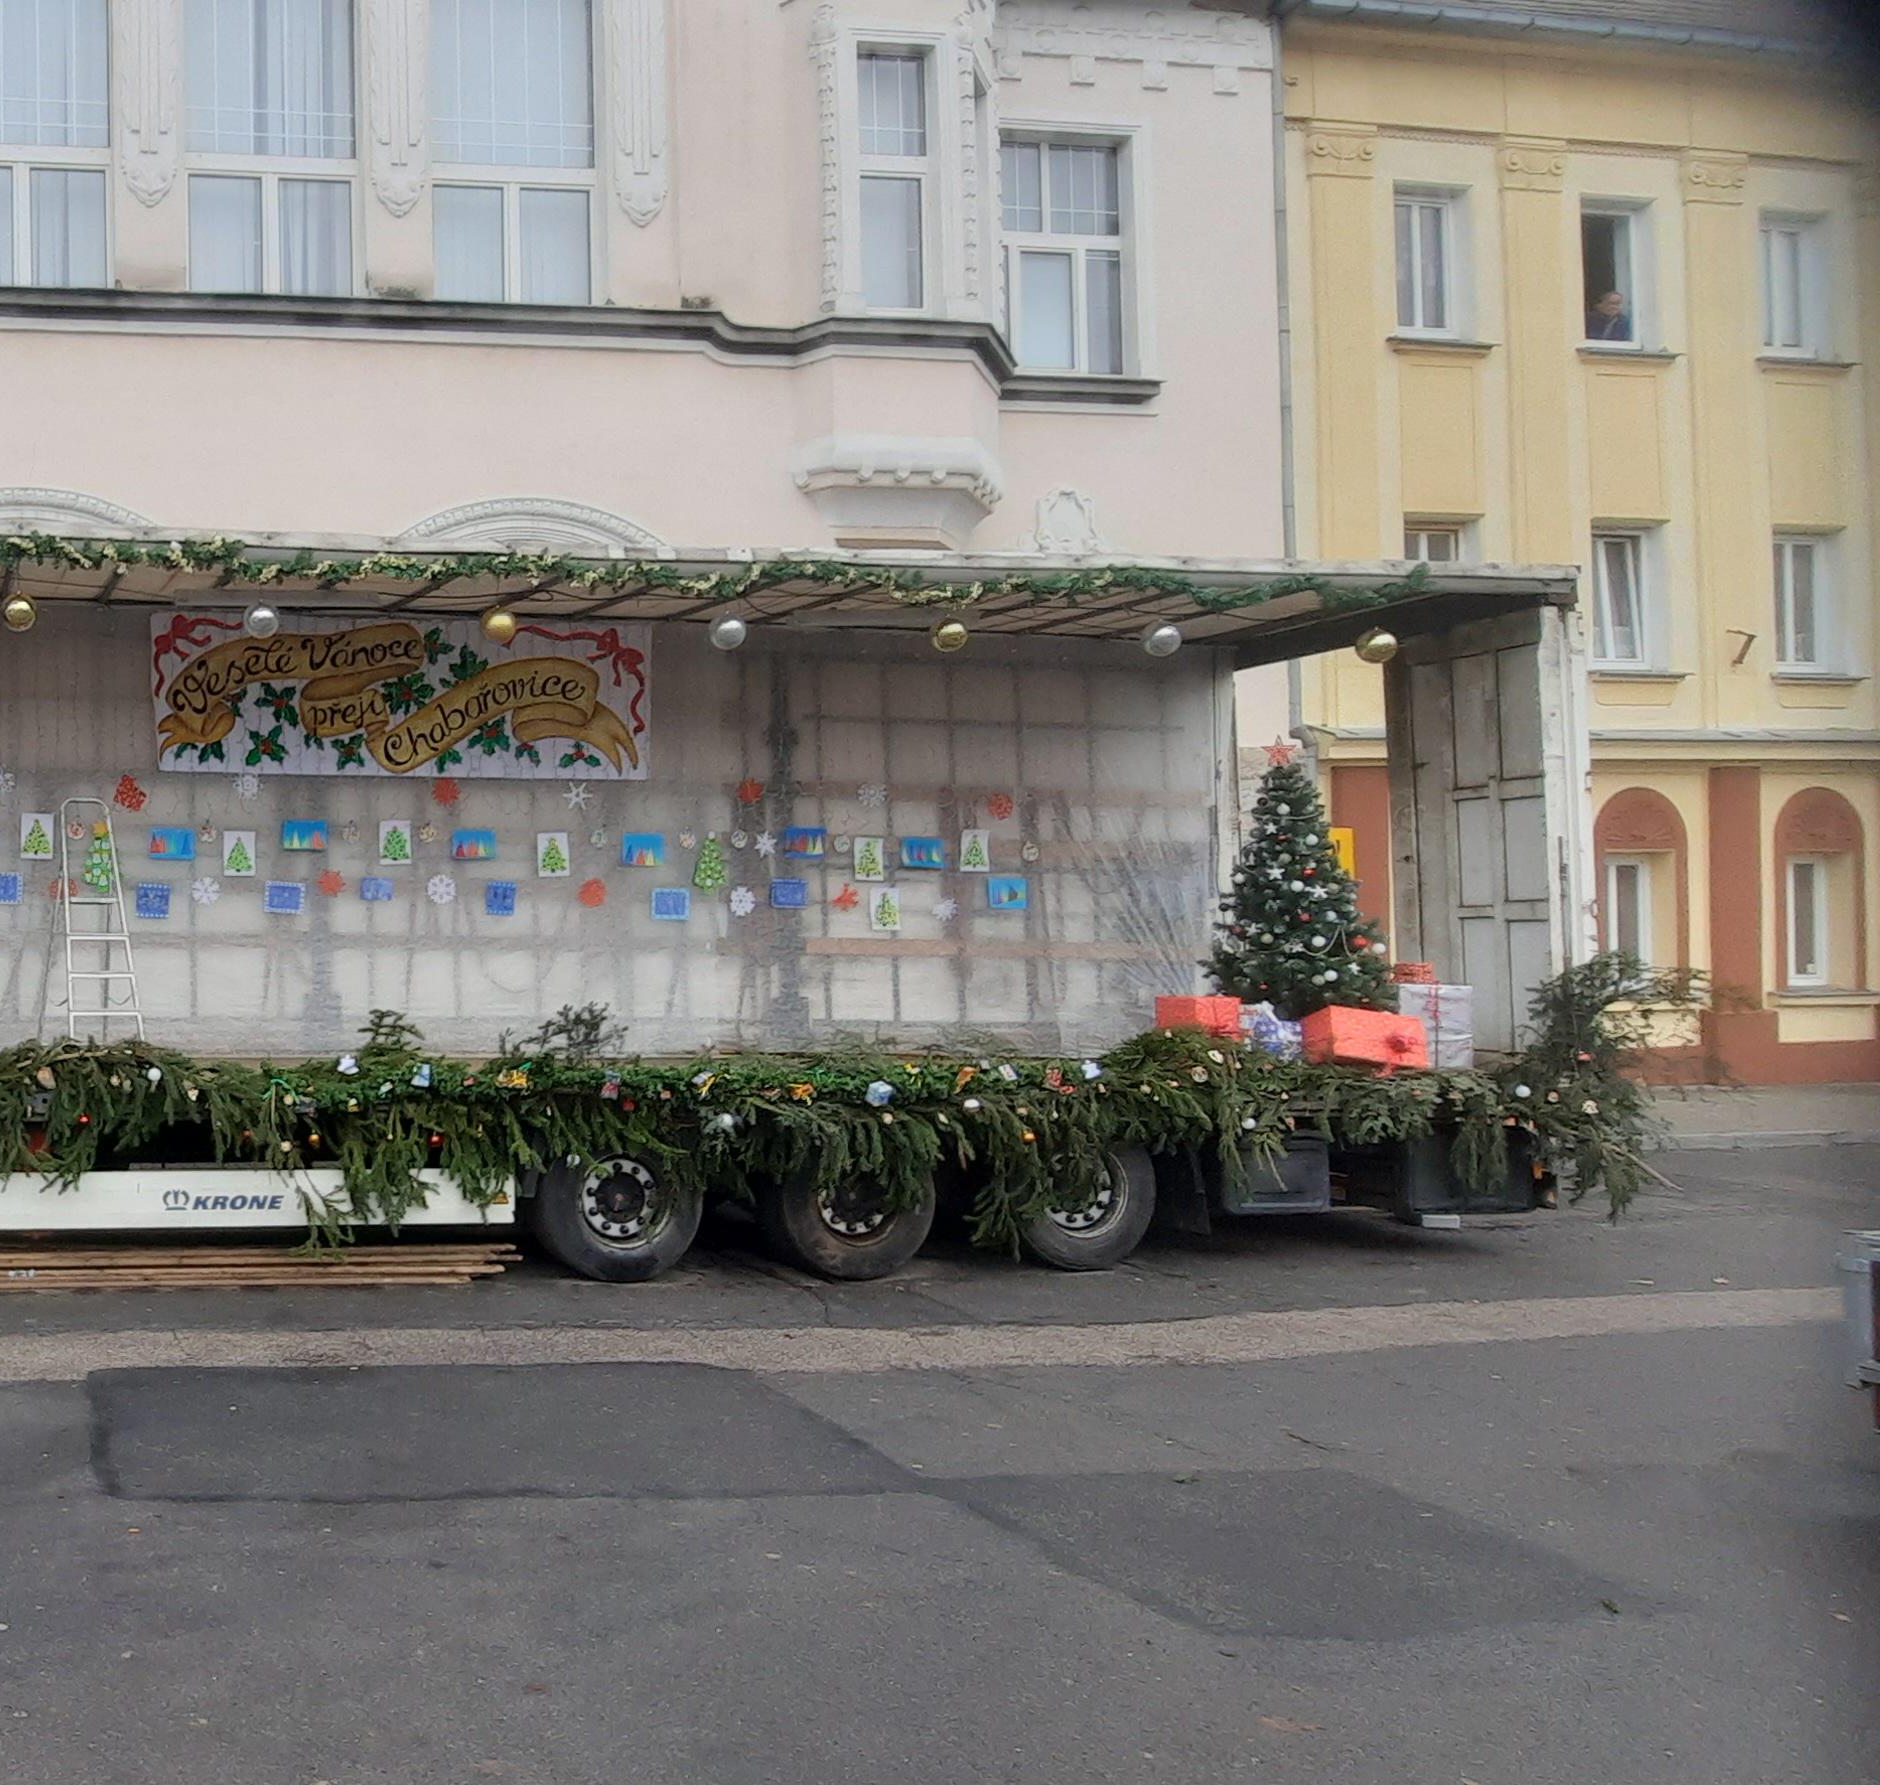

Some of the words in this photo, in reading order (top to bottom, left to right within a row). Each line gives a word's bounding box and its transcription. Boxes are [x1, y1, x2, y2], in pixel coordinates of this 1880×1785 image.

[173, 639, 298, 714] Veselé
[301, 634, 424, 671] Vánoce
[383, 669, 586, 766] Chabařovice
[192, 1195, 285, 1210] KRONE
